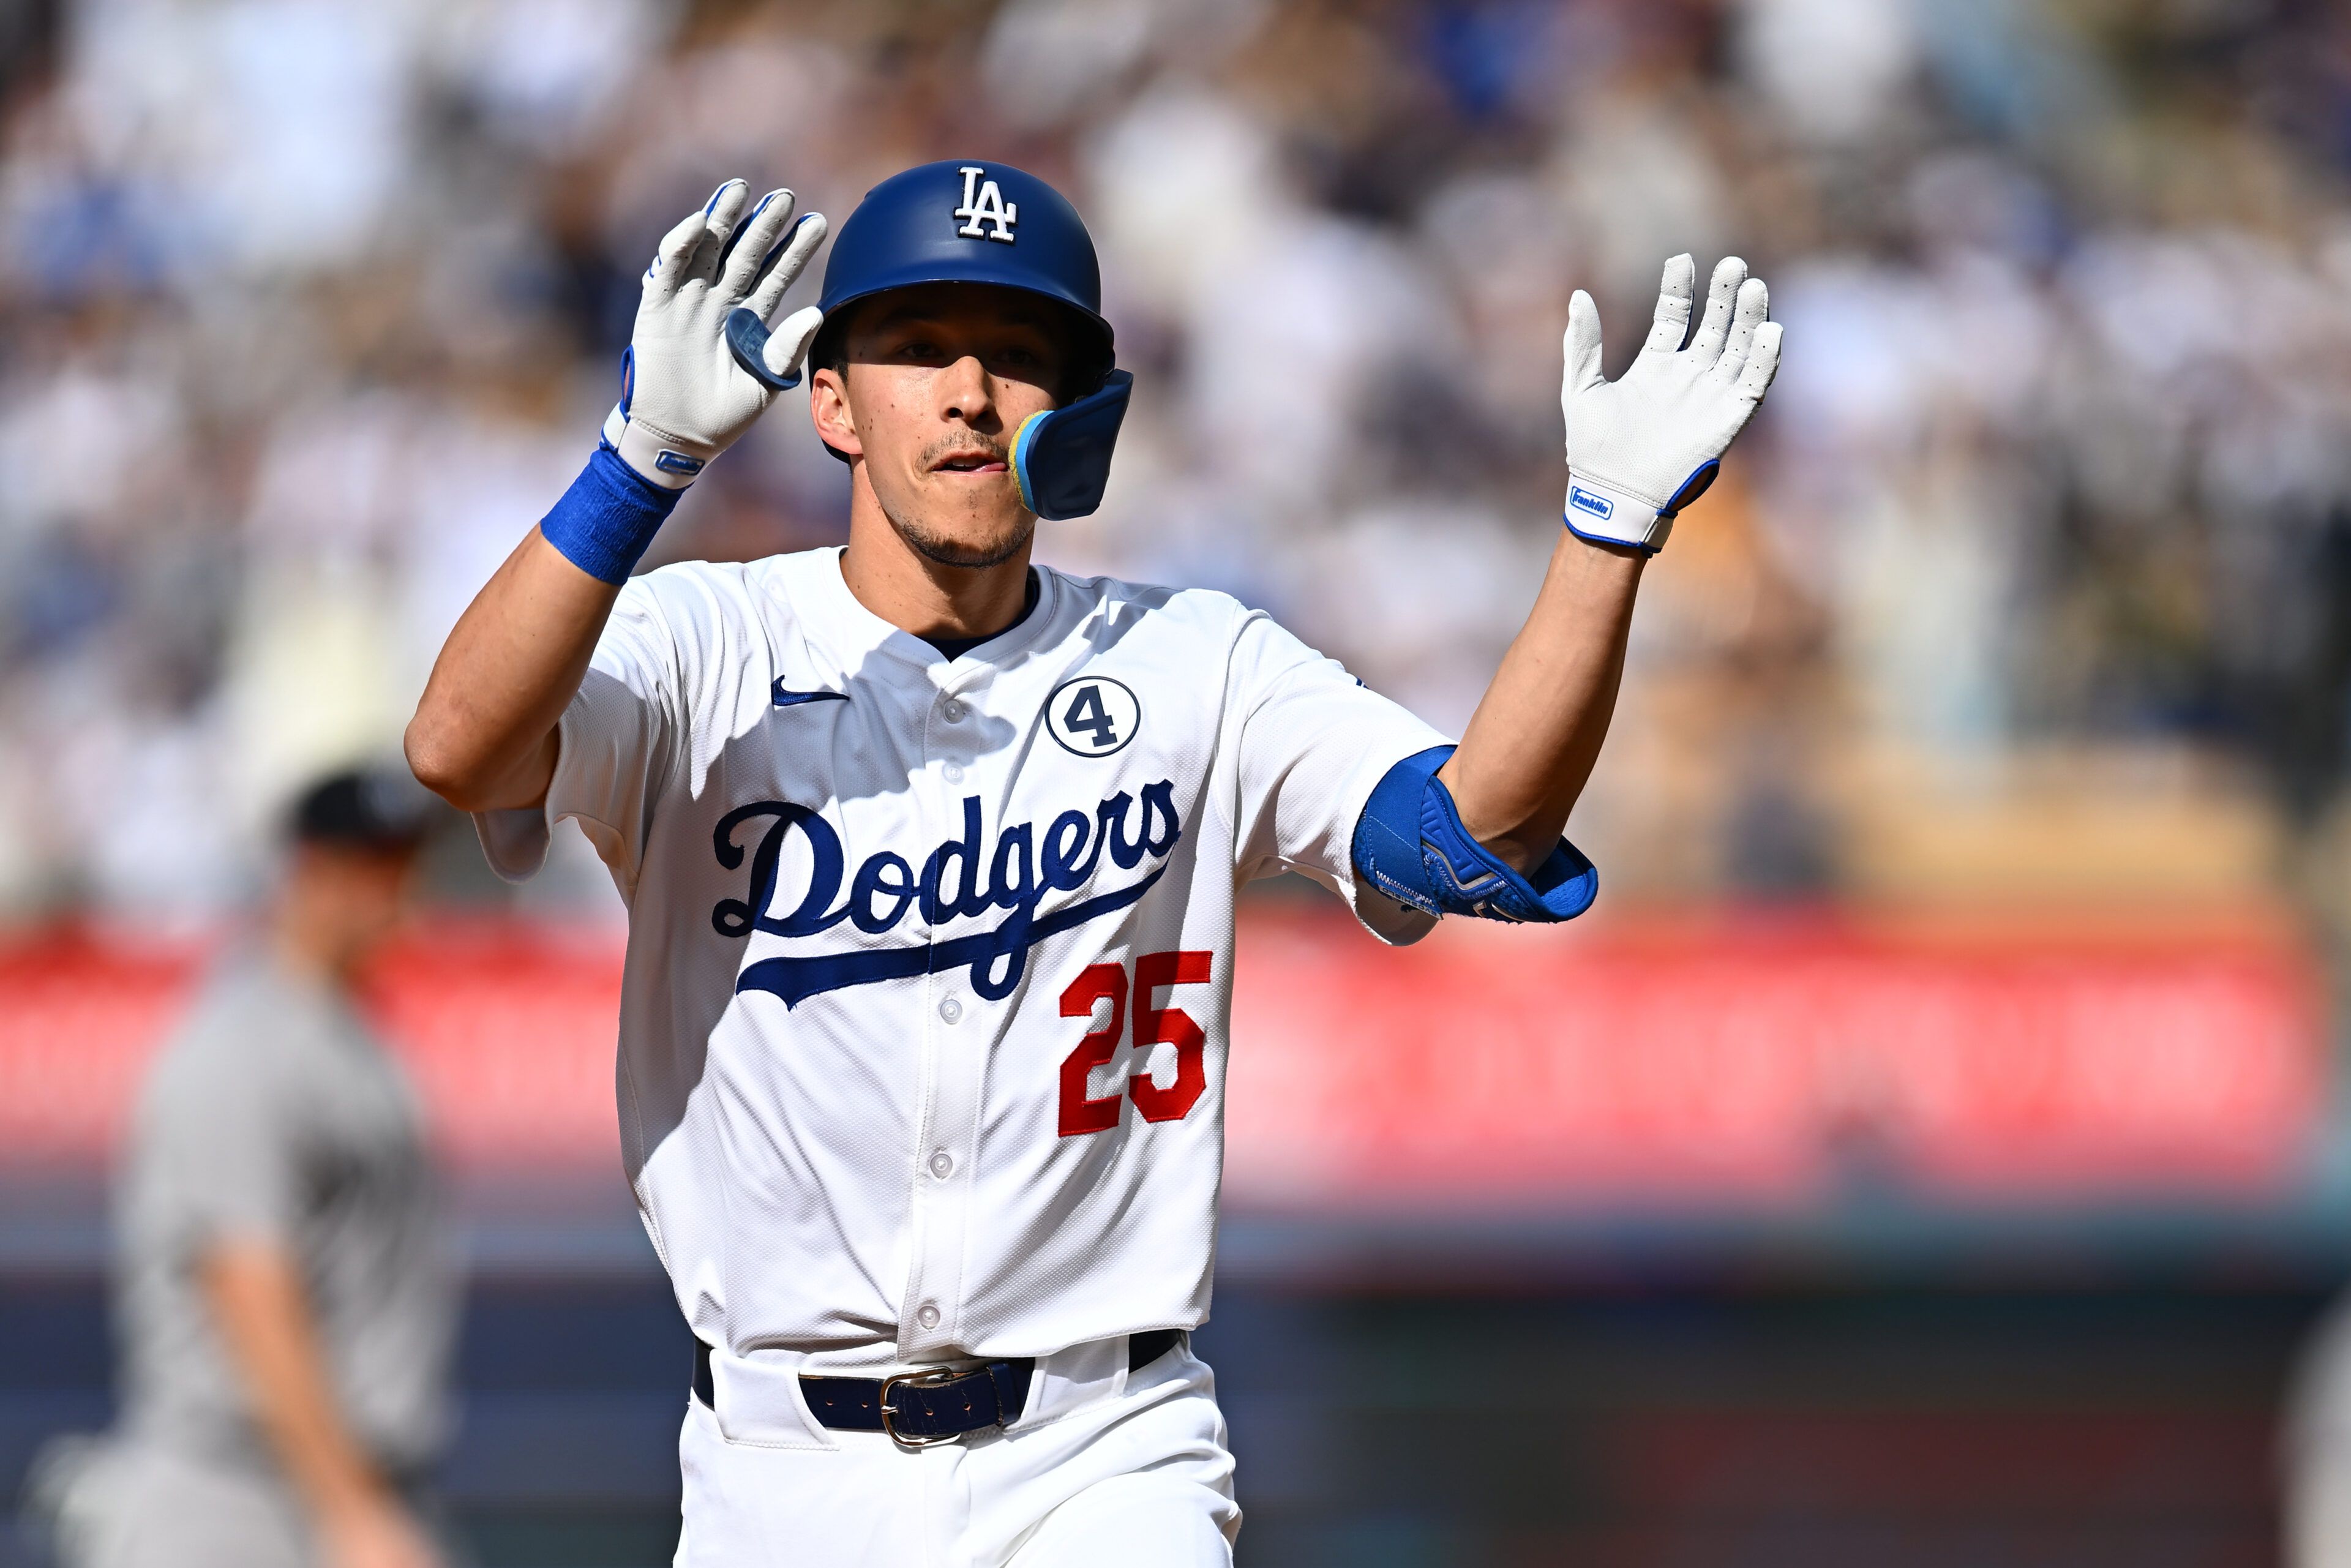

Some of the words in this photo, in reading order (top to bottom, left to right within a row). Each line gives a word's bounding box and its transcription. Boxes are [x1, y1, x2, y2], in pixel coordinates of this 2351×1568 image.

[955, 167, 1016, 241] LA
[1572, 489, 1608, 514] Franklin
[1063, 685, 1119, 747] 4
[711, 778, 1181, 1001] Dodgers
[1058, 950, 1213, 1138] 25
